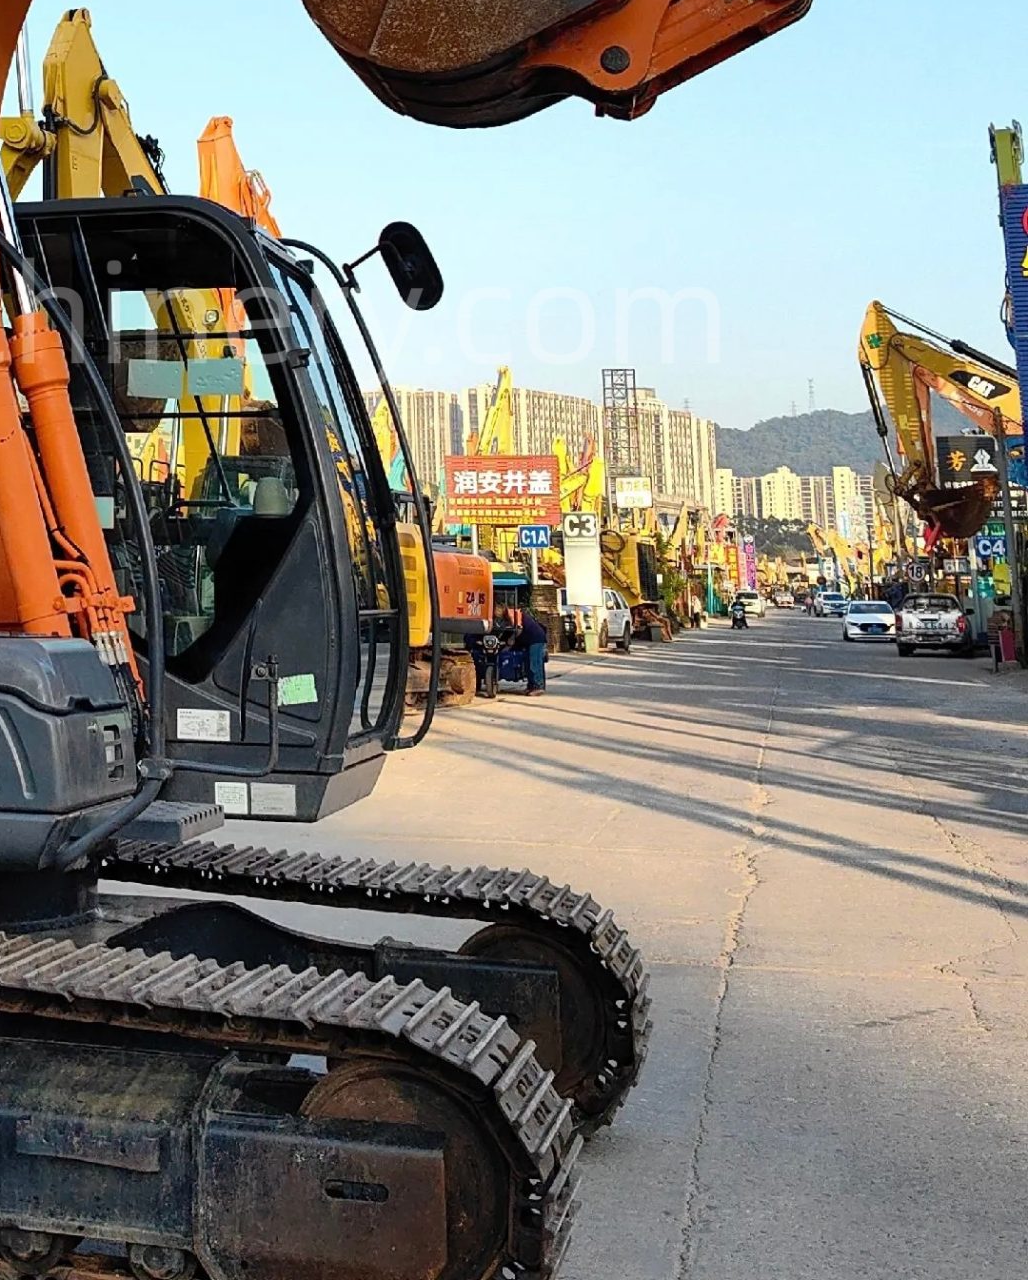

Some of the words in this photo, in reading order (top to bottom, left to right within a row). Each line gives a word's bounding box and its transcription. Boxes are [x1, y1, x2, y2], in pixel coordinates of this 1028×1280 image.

[967, 375, 996, 398] CAT
[453, 468, 553, 495] 润安井盖
[563, 513, 597, 538] C3
[521, 529, 548, 545] C1A
[978, 539, 1006, 556] C4
[909, 564, 924, 579] 18
